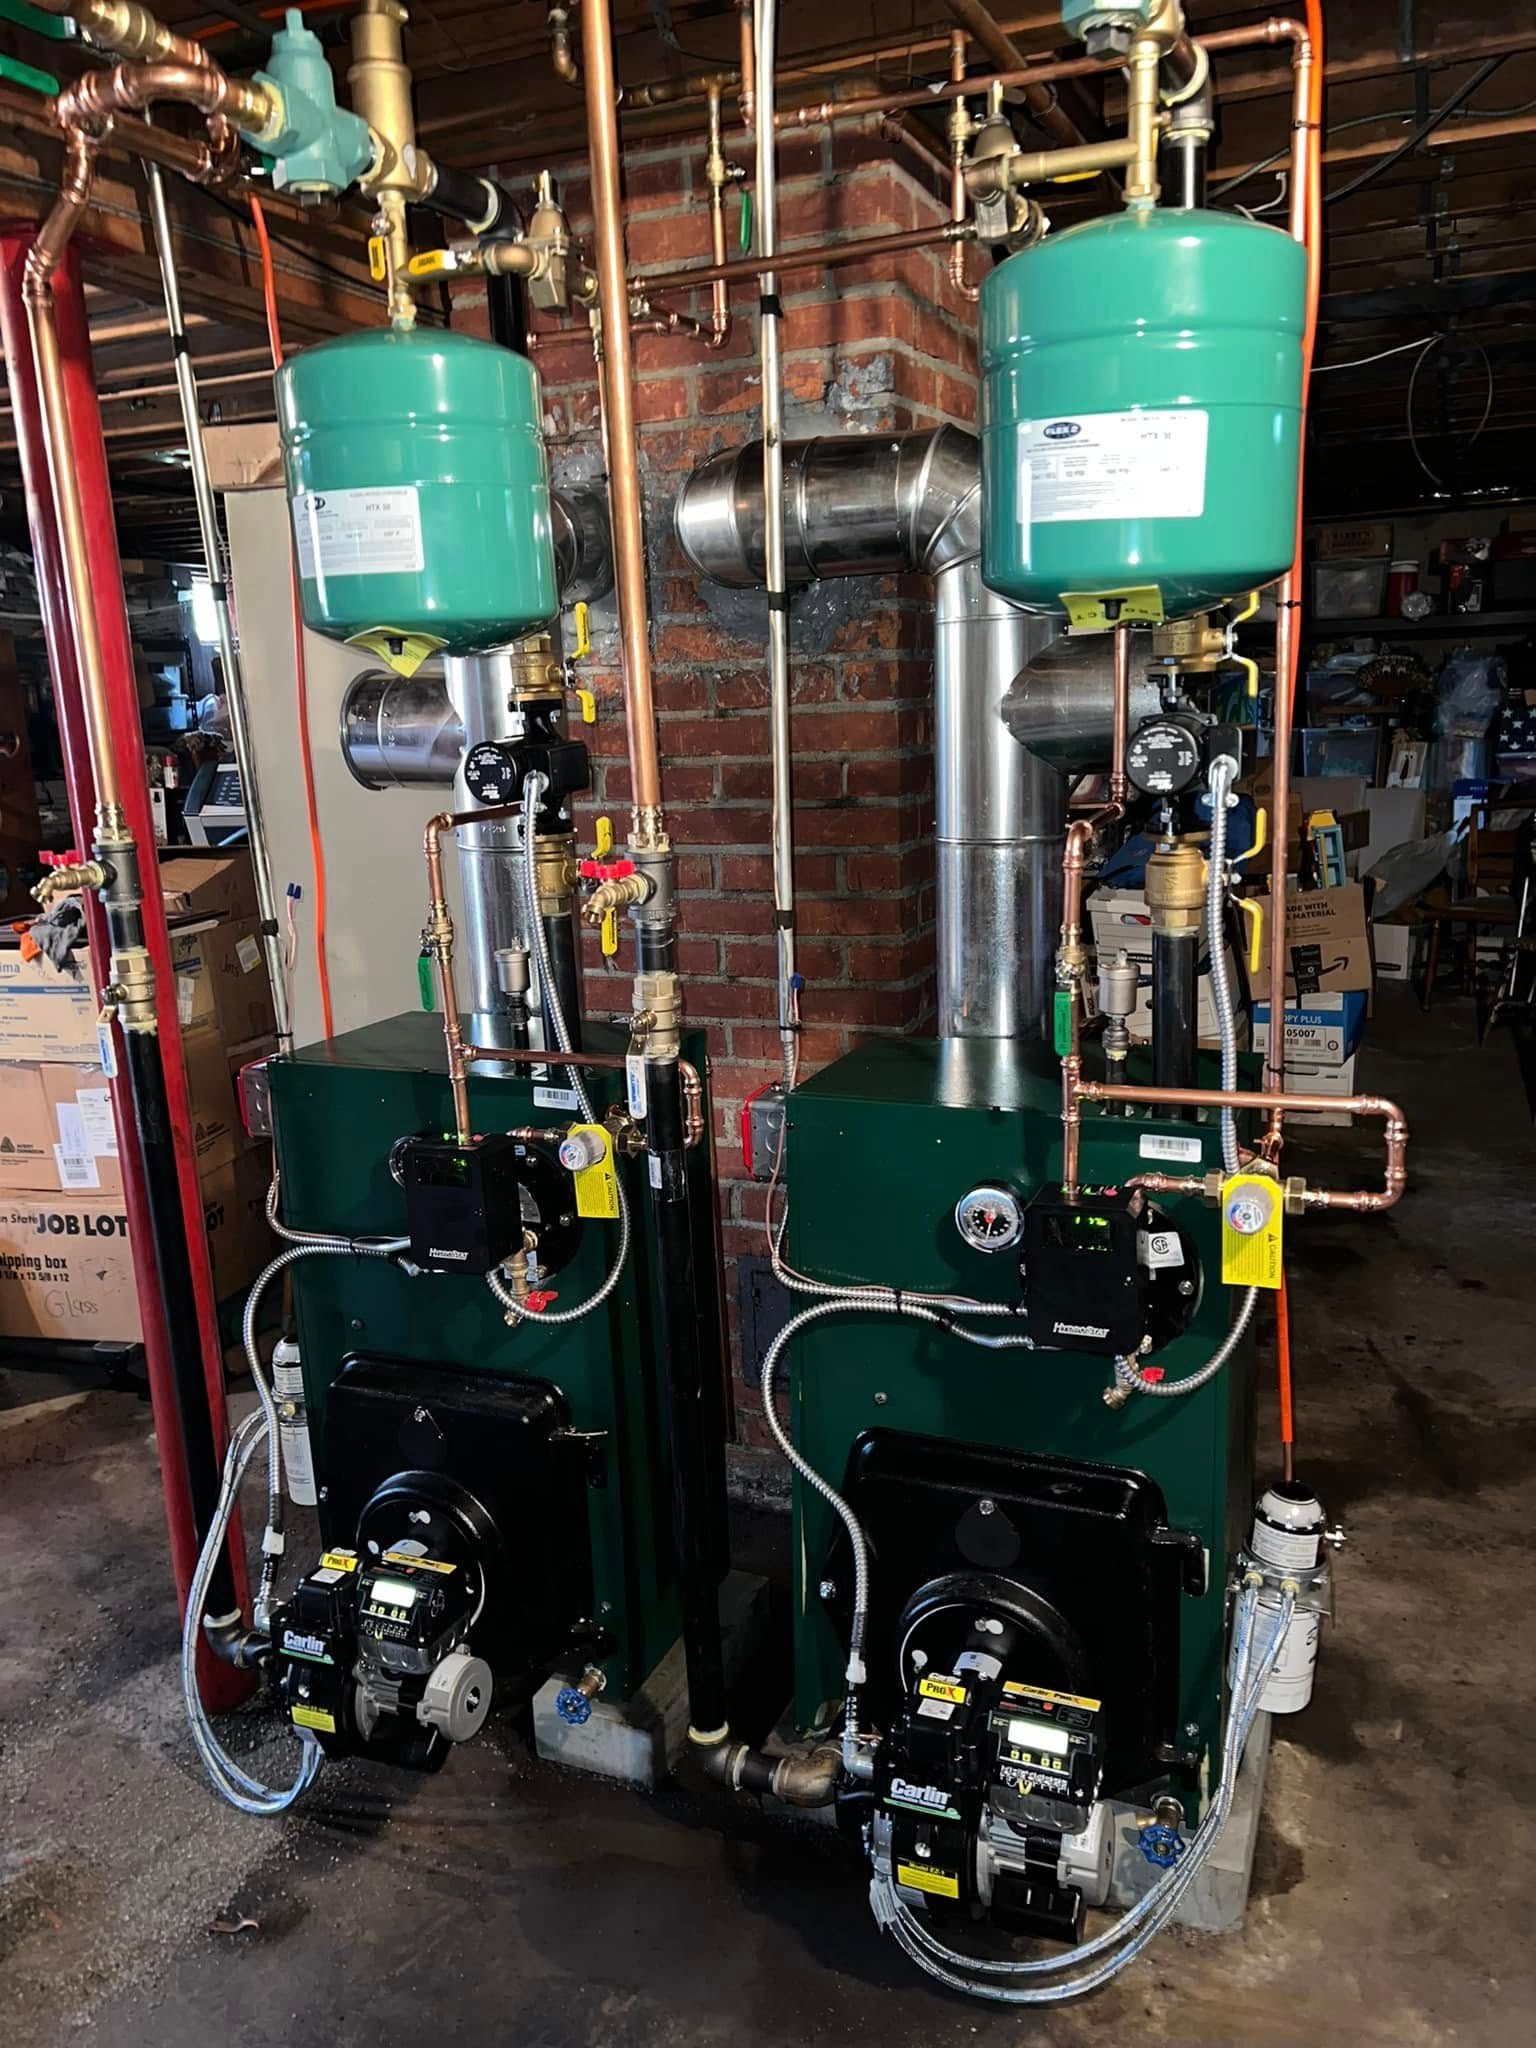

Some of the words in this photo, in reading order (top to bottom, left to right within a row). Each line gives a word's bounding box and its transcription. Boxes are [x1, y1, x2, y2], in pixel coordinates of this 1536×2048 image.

[1304, 901, 1328, 911] WITH
[1293, 909, 1337, 920] MATERIAL
[1300, 1014, 1322, 1024] PLUS
[1286, 1028, 1316, 1038] 05007
[37, 1213, 80, 1235] JOB
[83, 1214, 128, 1238] LOT
[44, 1254, 68, 1269] box
[1268, 1244, 1276, 1280] CAUTION
[283, 1630, 326, 1653] Carlin
[890, 1777, 949, 1805] Carlin
